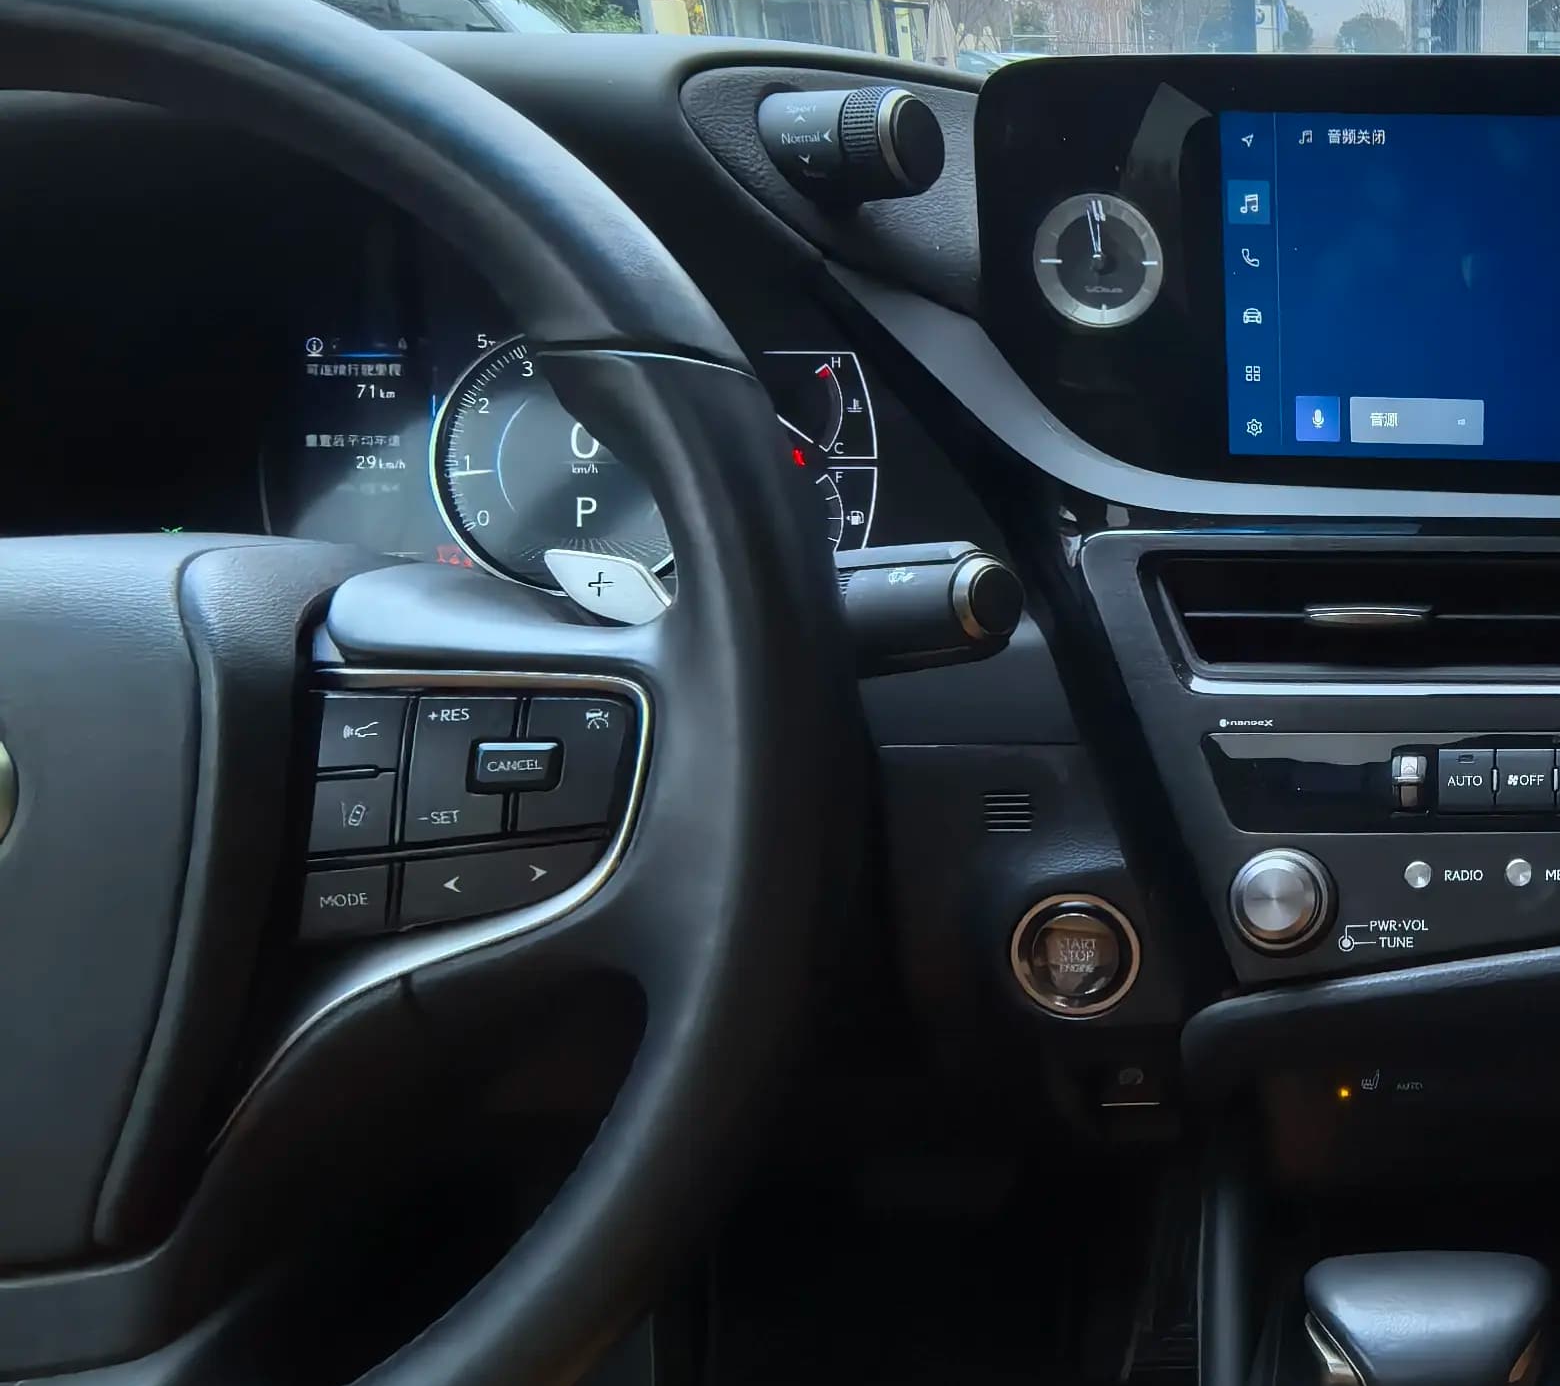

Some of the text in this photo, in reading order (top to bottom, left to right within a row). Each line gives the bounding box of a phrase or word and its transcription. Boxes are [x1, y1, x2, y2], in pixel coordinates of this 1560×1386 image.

[781, 131, 821, 145] Normal
[1327, 128, 1386, 146] 音频关闭
[521, 361, 534, 377] 3
[831, 356, 841, 369] H
[357, 384, 396, 399] 71 km
[478, 397, 490, 414] 2
[834, 442, 844, 455] C
[356, 455, 406, 469] 29 km/h
[464, 455, 470, 470] 1
[571, 463, 599, 474] km/h
[835, 471, 844, 484] F
[476, 510, 490, 526] 0
[576, 496, 597, 528] P
[486, 758, 543, 772] CANCEL
[1447, 774, 1483, 787] AUTO
[1519, 774, 1545, 787] OFF
[1443, 869, 1484, 882] RADIO
[319, 892, 369, 909] MODE
[1378, 936, 1415, 949] TUNE
